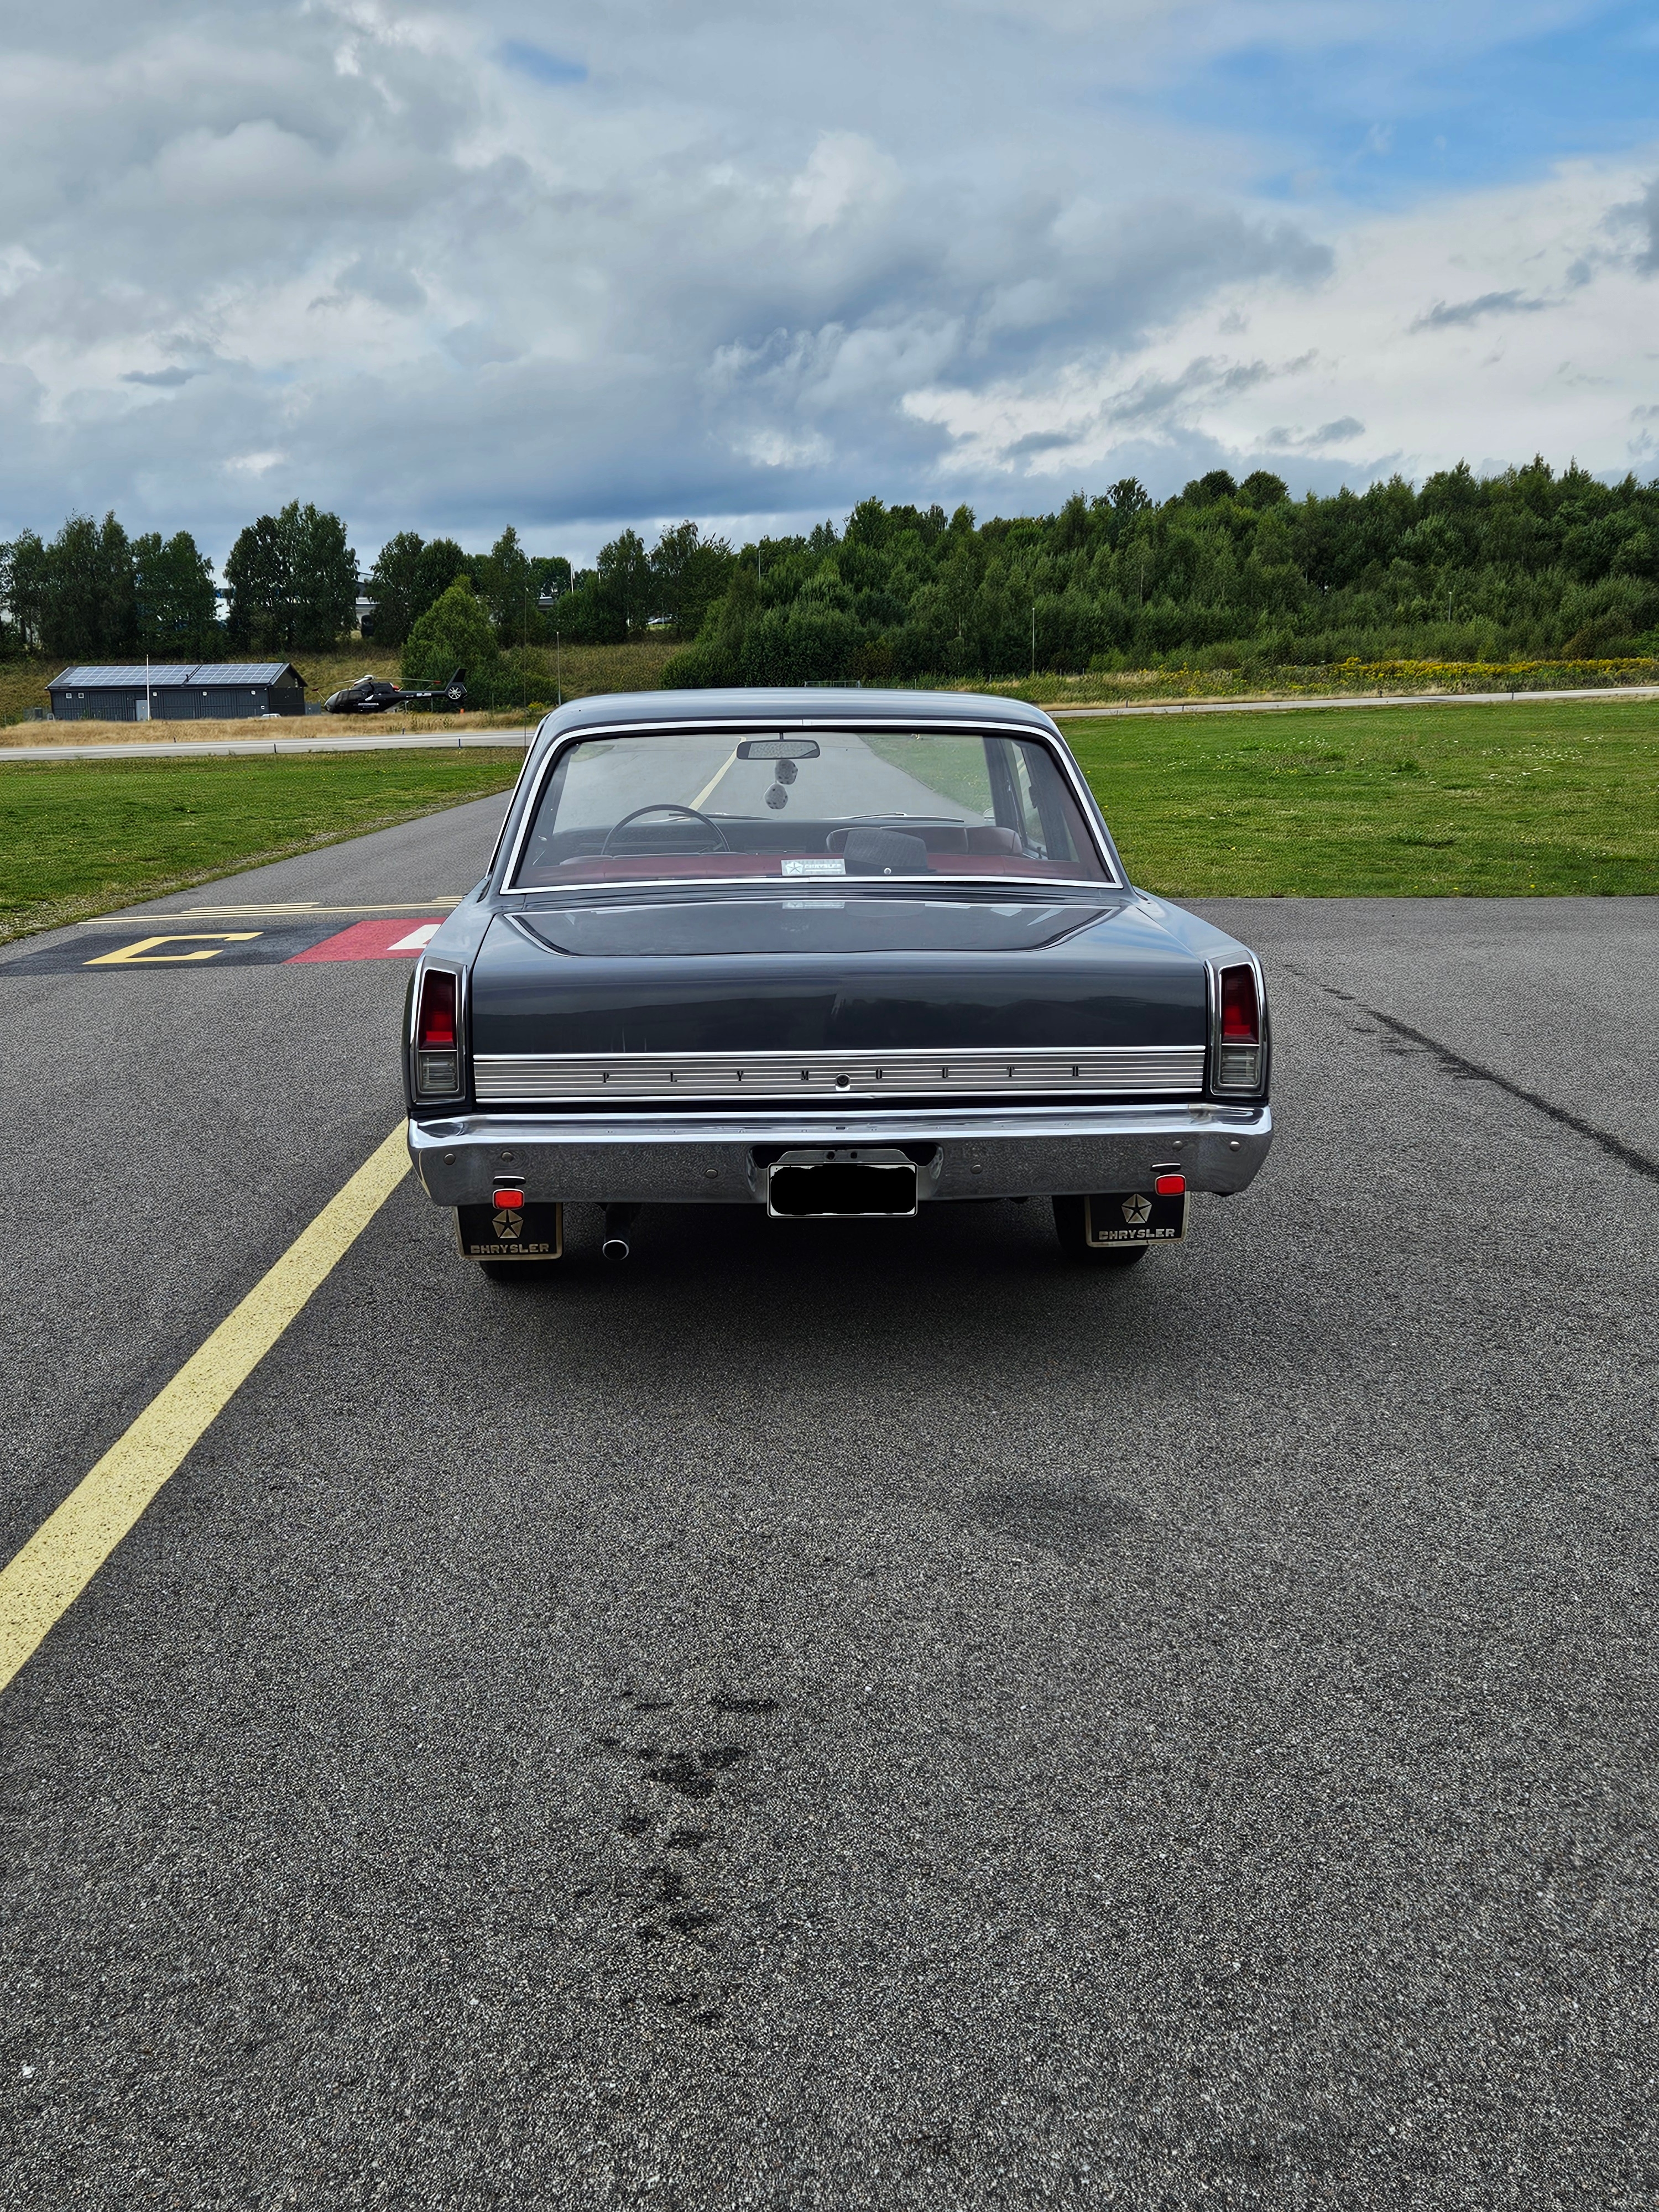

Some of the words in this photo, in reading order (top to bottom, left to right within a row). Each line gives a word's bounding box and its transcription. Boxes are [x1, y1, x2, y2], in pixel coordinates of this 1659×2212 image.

[603, 1066, 1079, 1083] PLYMOUTH
[1098, 1228, 1175, 1240] CHRYSLER
[470, 1243, 549, 1254] CHRYSLER
